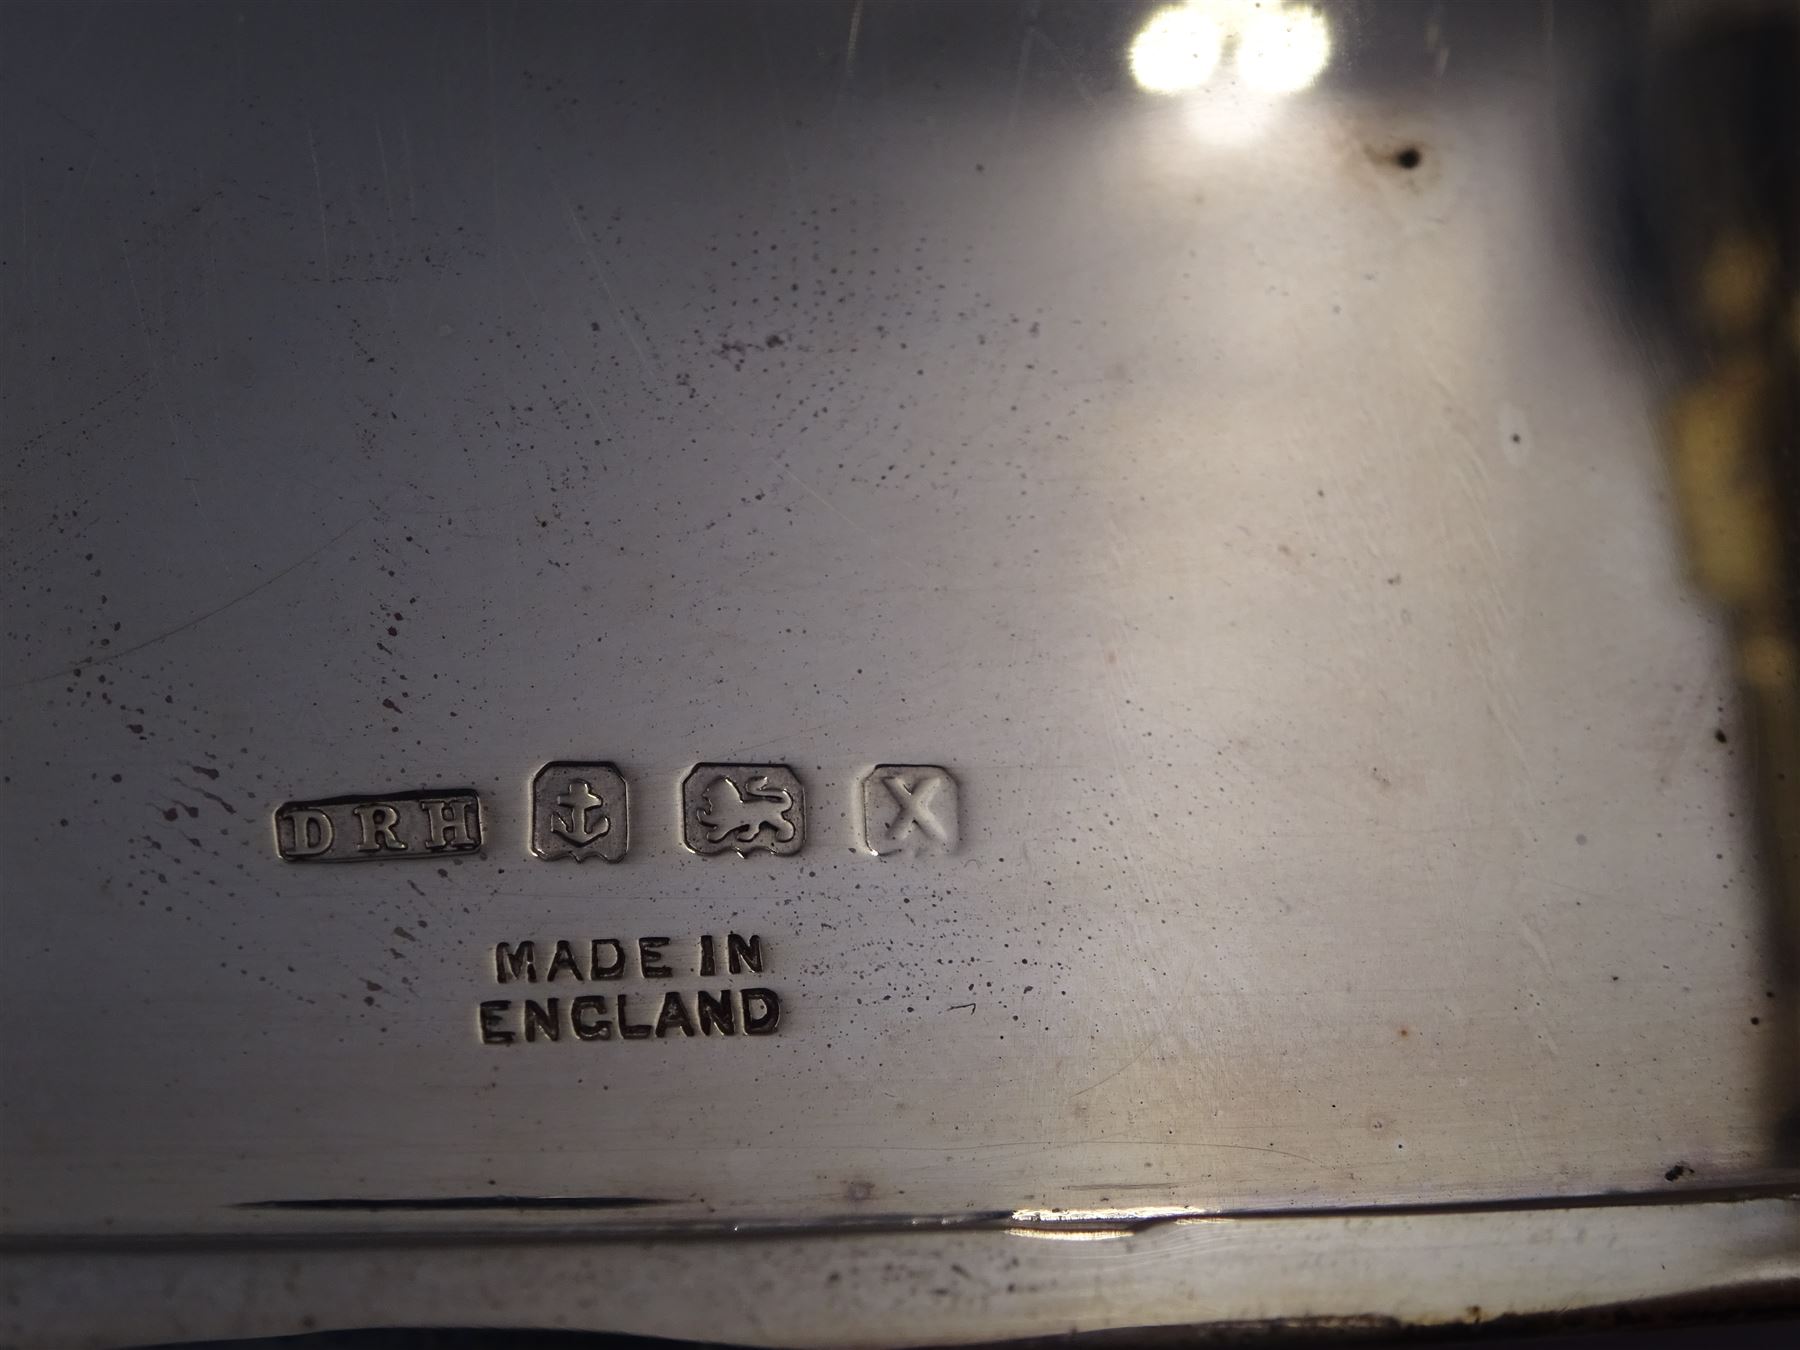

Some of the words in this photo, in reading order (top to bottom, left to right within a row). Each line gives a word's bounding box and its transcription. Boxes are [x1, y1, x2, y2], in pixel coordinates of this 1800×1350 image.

[881, 775, 944, 842] X
[496, 937, 673, 984] MADE
[699, 934, 764, 977] IN
[478, 987, 781, 1044] ENGLAND
